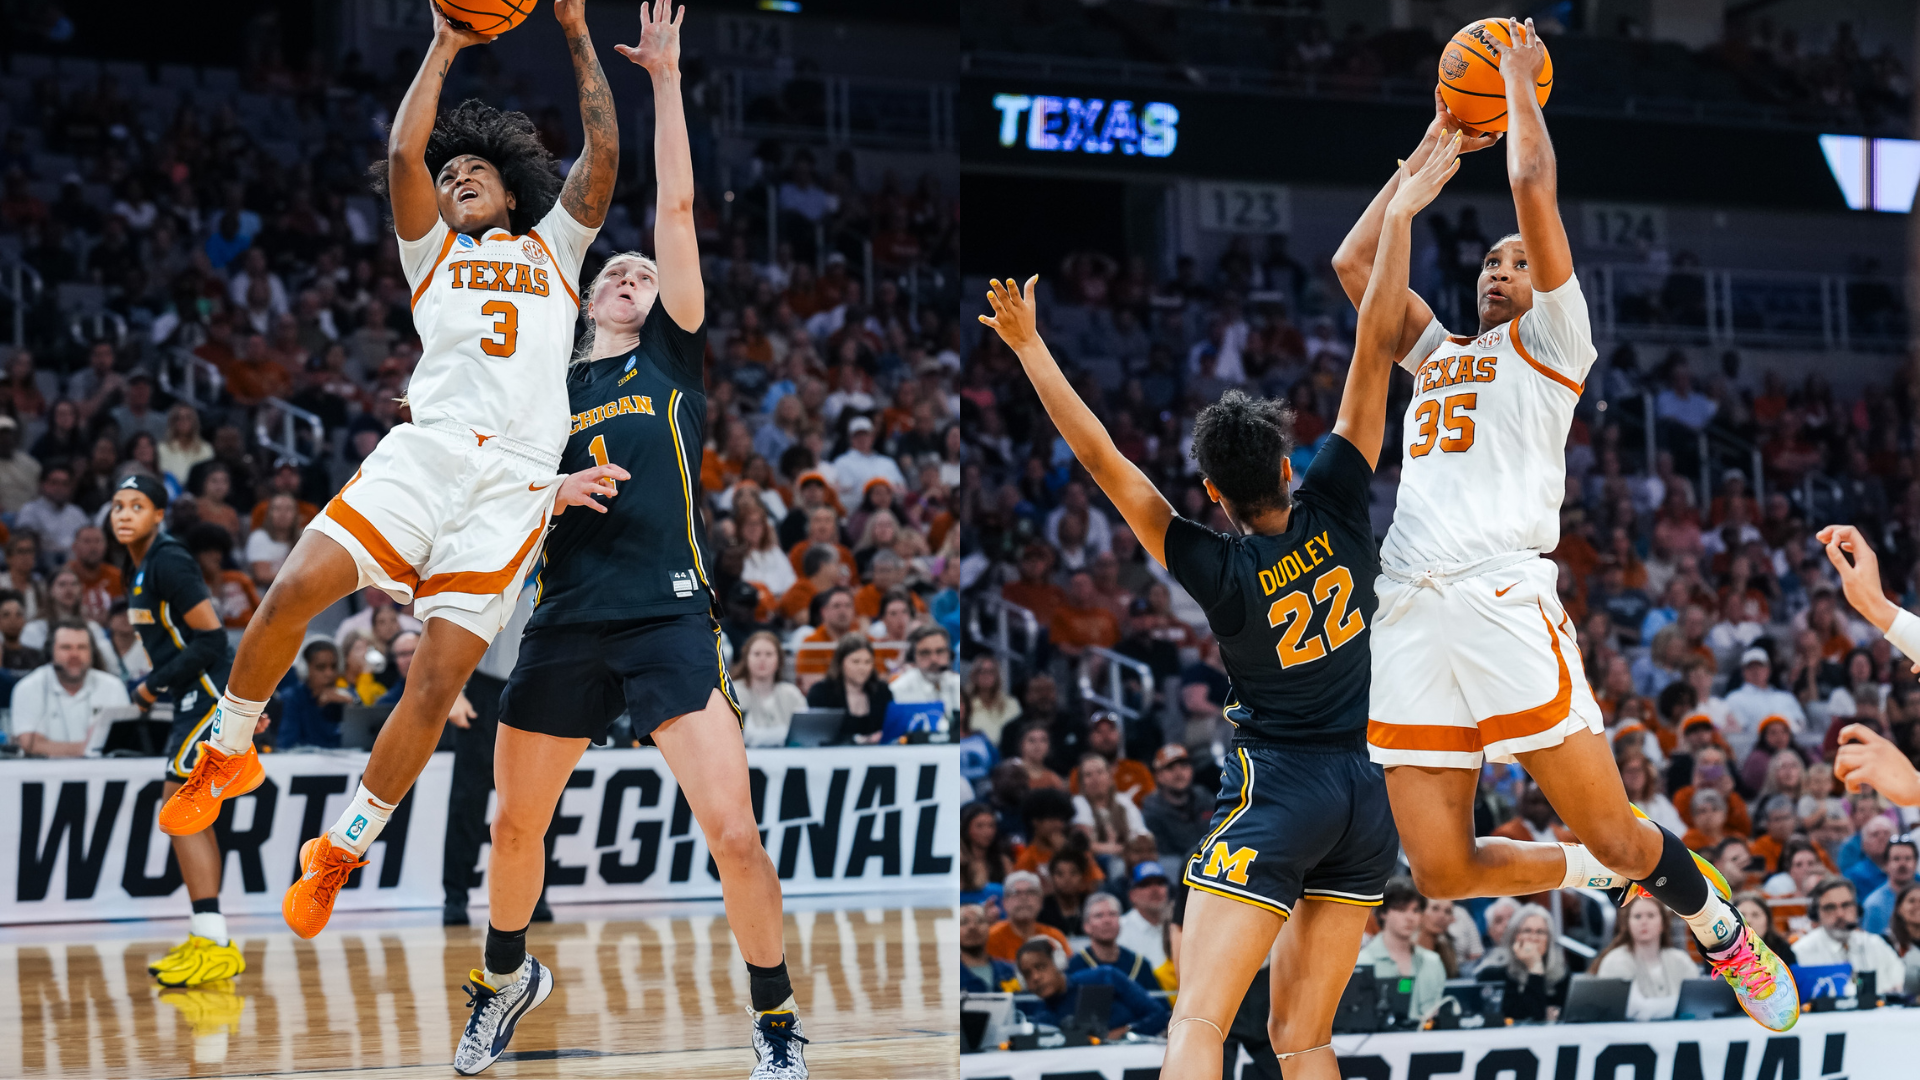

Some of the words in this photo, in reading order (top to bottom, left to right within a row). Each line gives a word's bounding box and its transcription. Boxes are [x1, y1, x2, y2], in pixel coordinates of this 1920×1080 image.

[992, 93, 1180, 158] TEXAS
[1213, 189, 1280, 228] 123
[1595, 210, 1656, 246] 124
[523, 241, 543, 259] SEC
[448, 260, 550, 297] TEXAS
[480, 300, 518, 358] 3
[1478, 332, 1500, 348] SEC
[1415, 355, 1498, 398] TEXAS
[570, 395, 656, 436] CHIGAN
[1410, 393, 1478, 459] 35
[588, 434, 617, 496] 1
[1258, 530, 1334, 596] DUDLEY
[1267, 565, 1366, 670] 22
[17, 774, 417, 903] WORTH
[468, 764, 954, 889] EGINAL
[1202, 841, 1259, 886] M
